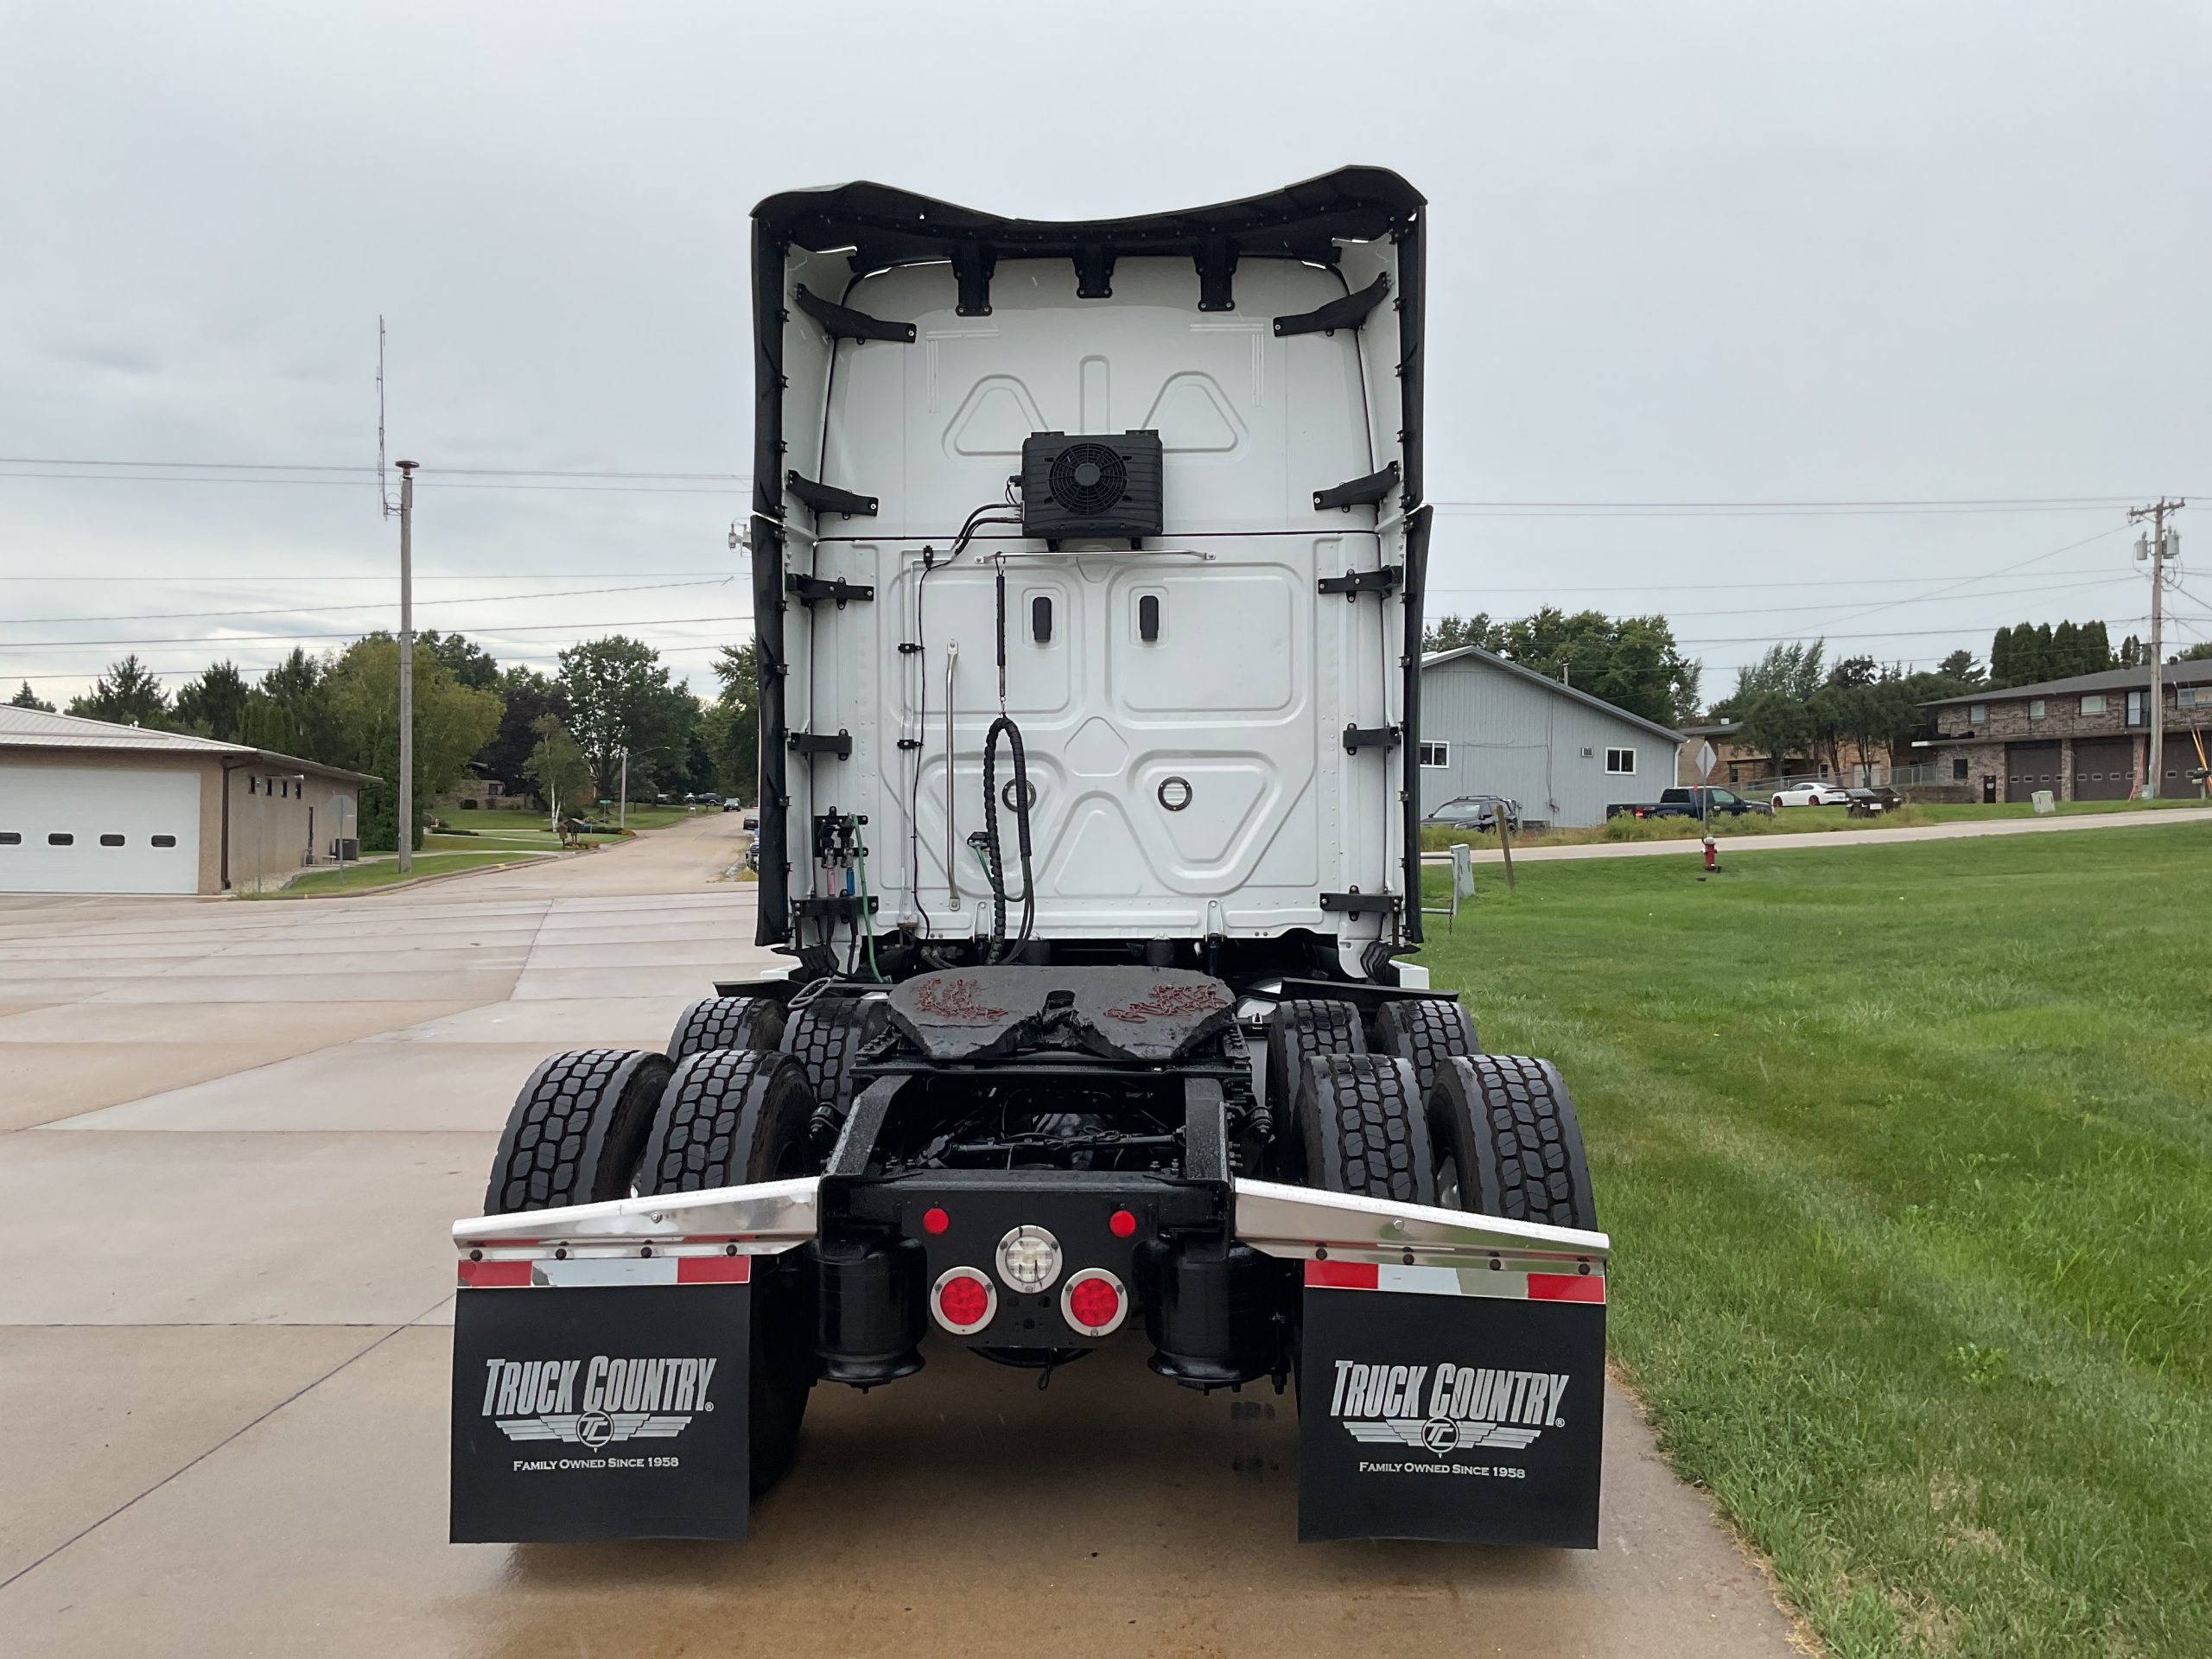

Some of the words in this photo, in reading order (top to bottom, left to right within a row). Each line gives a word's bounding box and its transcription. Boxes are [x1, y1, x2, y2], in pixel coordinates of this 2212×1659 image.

[482, 1358, 581, 1416] TRUCK
[583, 1355, 717, 1413] COUNTRY
[1331, 1360, 1427, 1417] TRUCK
[1428, 1363, 1569, 1426] COUNTRY
[581, 1416, 610, 1441] TC
[1425, 1422, 1456, 1447] TC
[513, 1460, 557, 1471] FAMILY
[559, 1459, 606, 1470] OWNED
[607, 1457, 645, 1468] SINCE
[647, 1457, 679, 1467] 1958
[1359, 1462, 1403, 1472] FAMILY
[1404, 1462, 1451, 1474] OWNED
[1452, 1464, 1490, 1476] SINCE
[1492, 1466, 1526, 1478] 1958
